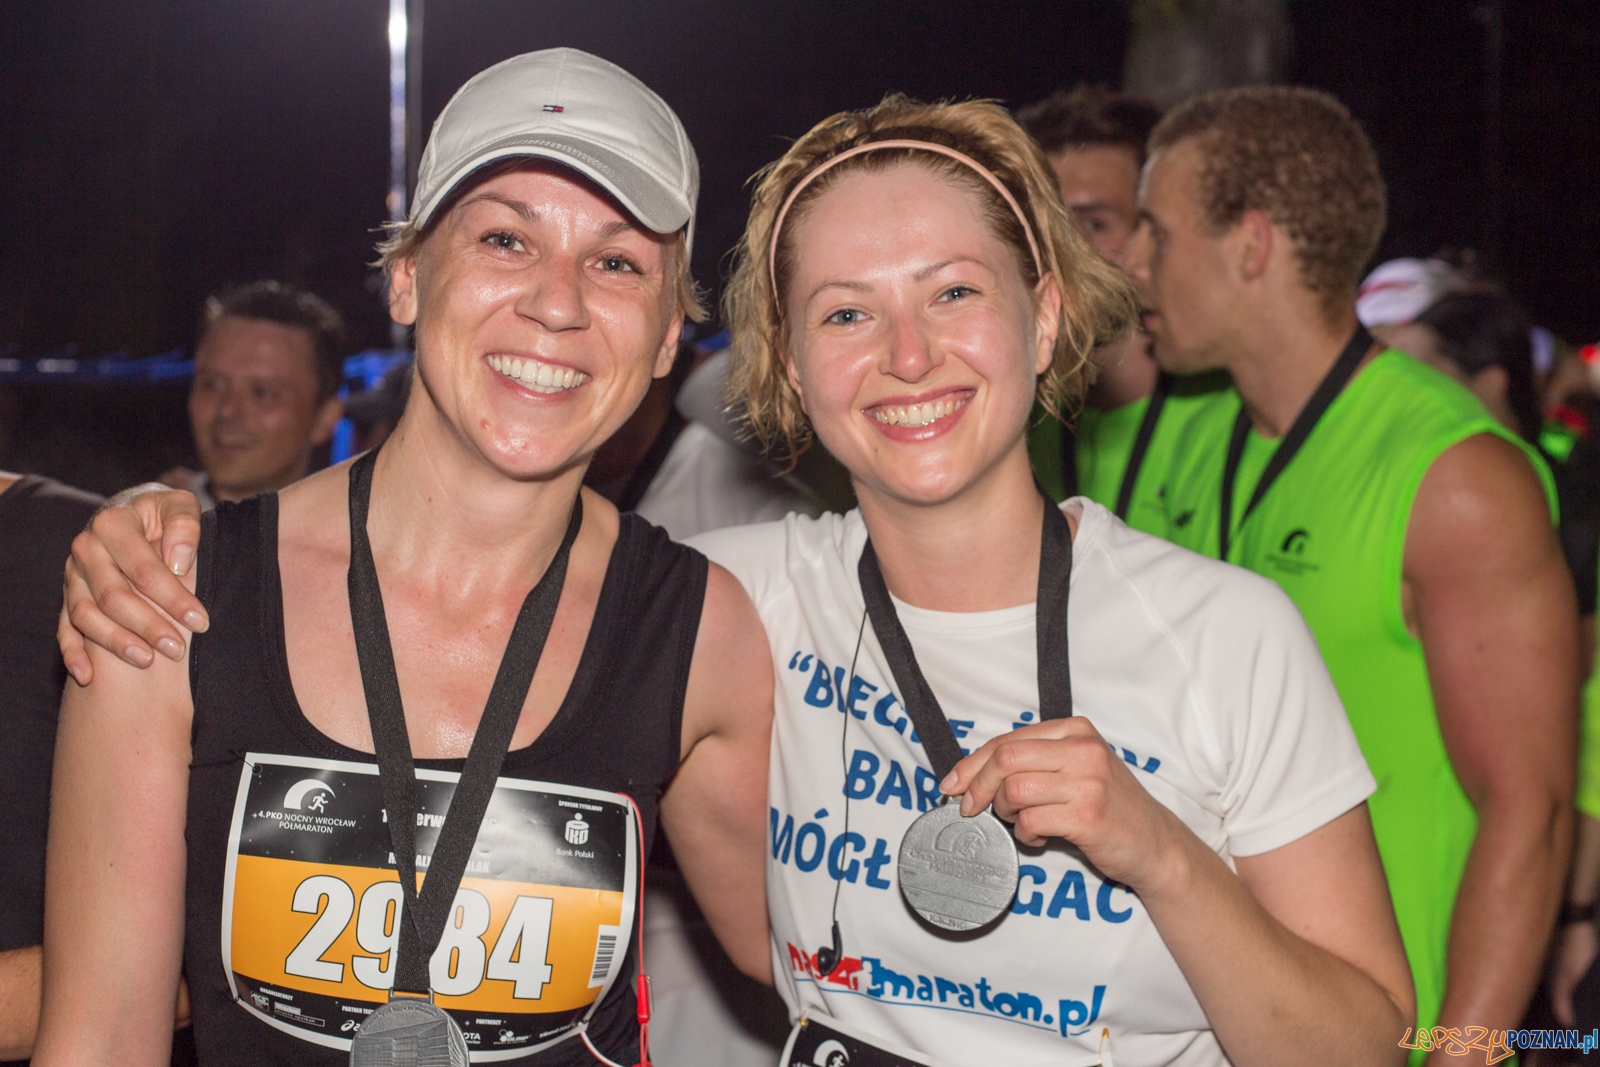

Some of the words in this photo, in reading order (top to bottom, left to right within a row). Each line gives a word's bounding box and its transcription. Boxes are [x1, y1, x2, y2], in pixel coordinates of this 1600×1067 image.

[278, 821, 333, 834] PÓŁMARATON
[284, 813, 314, 823] NOCNY
[315, 816, 356, 828] WROCŁAW
[556, 848, 573, 857] Bank
[574, 850, 595, 859] Polski
[769, 806, 891, 890] MÓGŁ
[284, 875, 554, 1000] 2984
[342, 1006, 362, 1014] PARTNER
